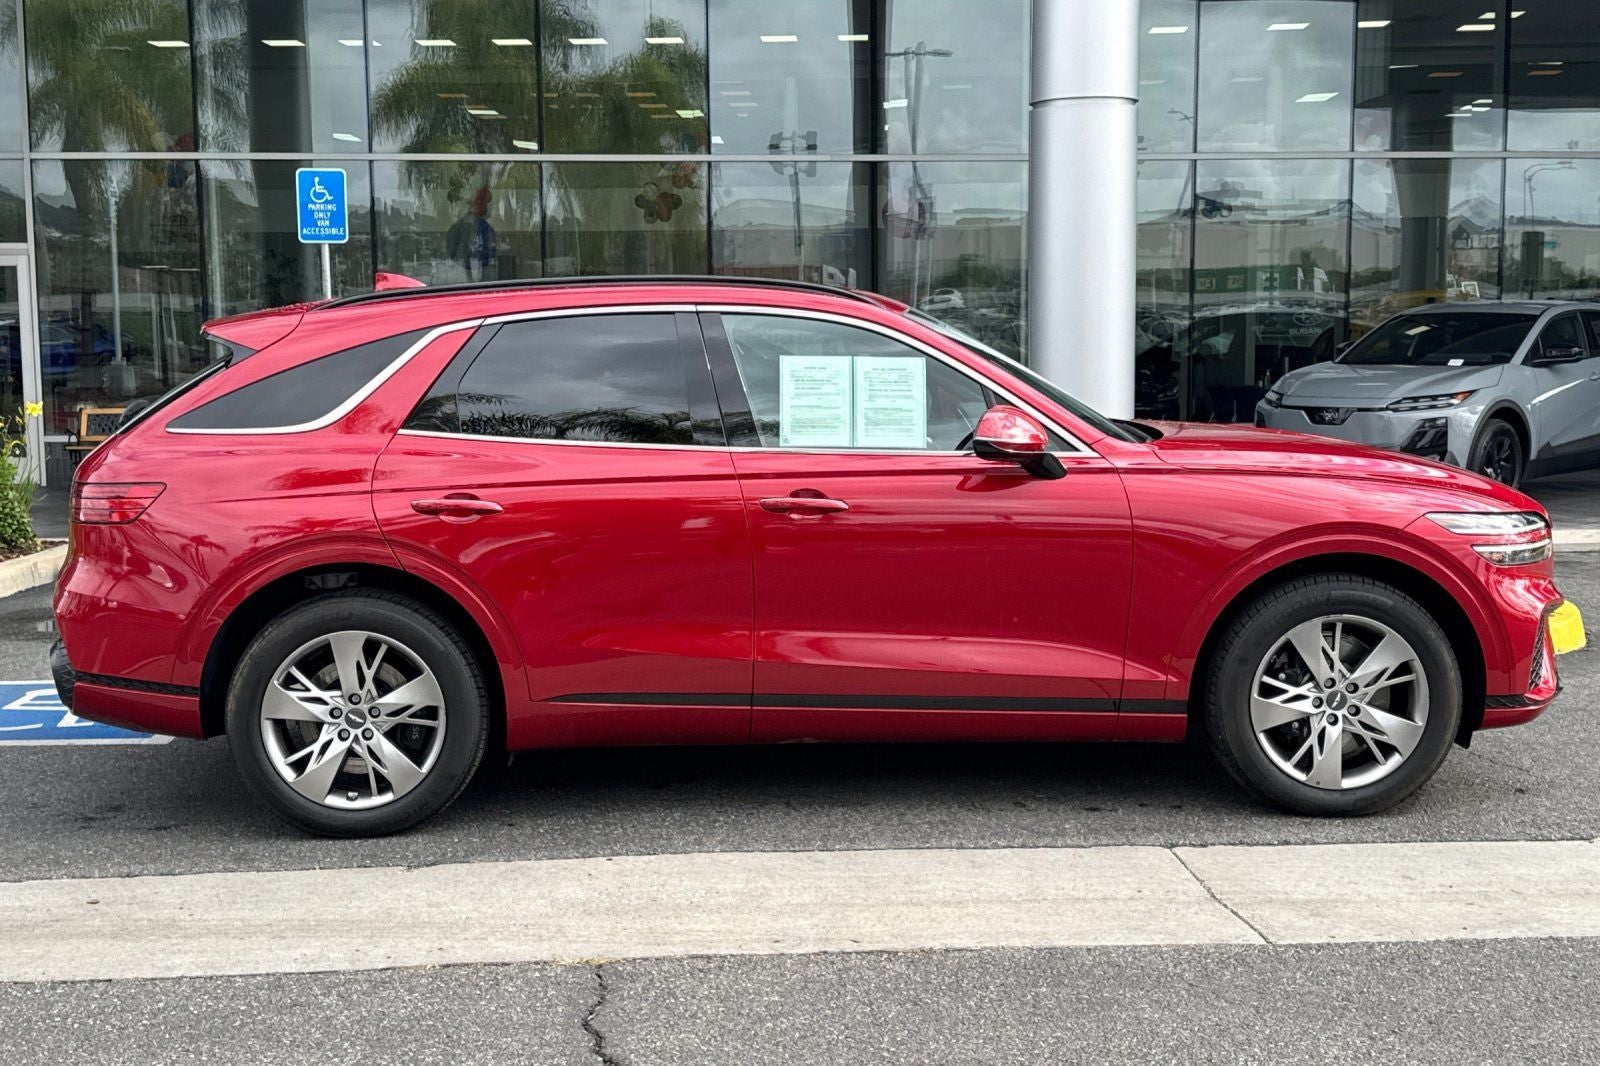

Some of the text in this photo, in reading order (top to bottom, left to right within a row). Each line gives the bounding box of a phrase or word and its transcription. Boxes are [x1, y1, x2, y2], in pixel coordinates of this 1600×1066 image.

[307, 203, 337, 211] PARKING
[313, 211, 331, 219] ONLY
[316, 219, 330, 227] VAN
[302, 227, 345, 235] ACCESSIBLE
